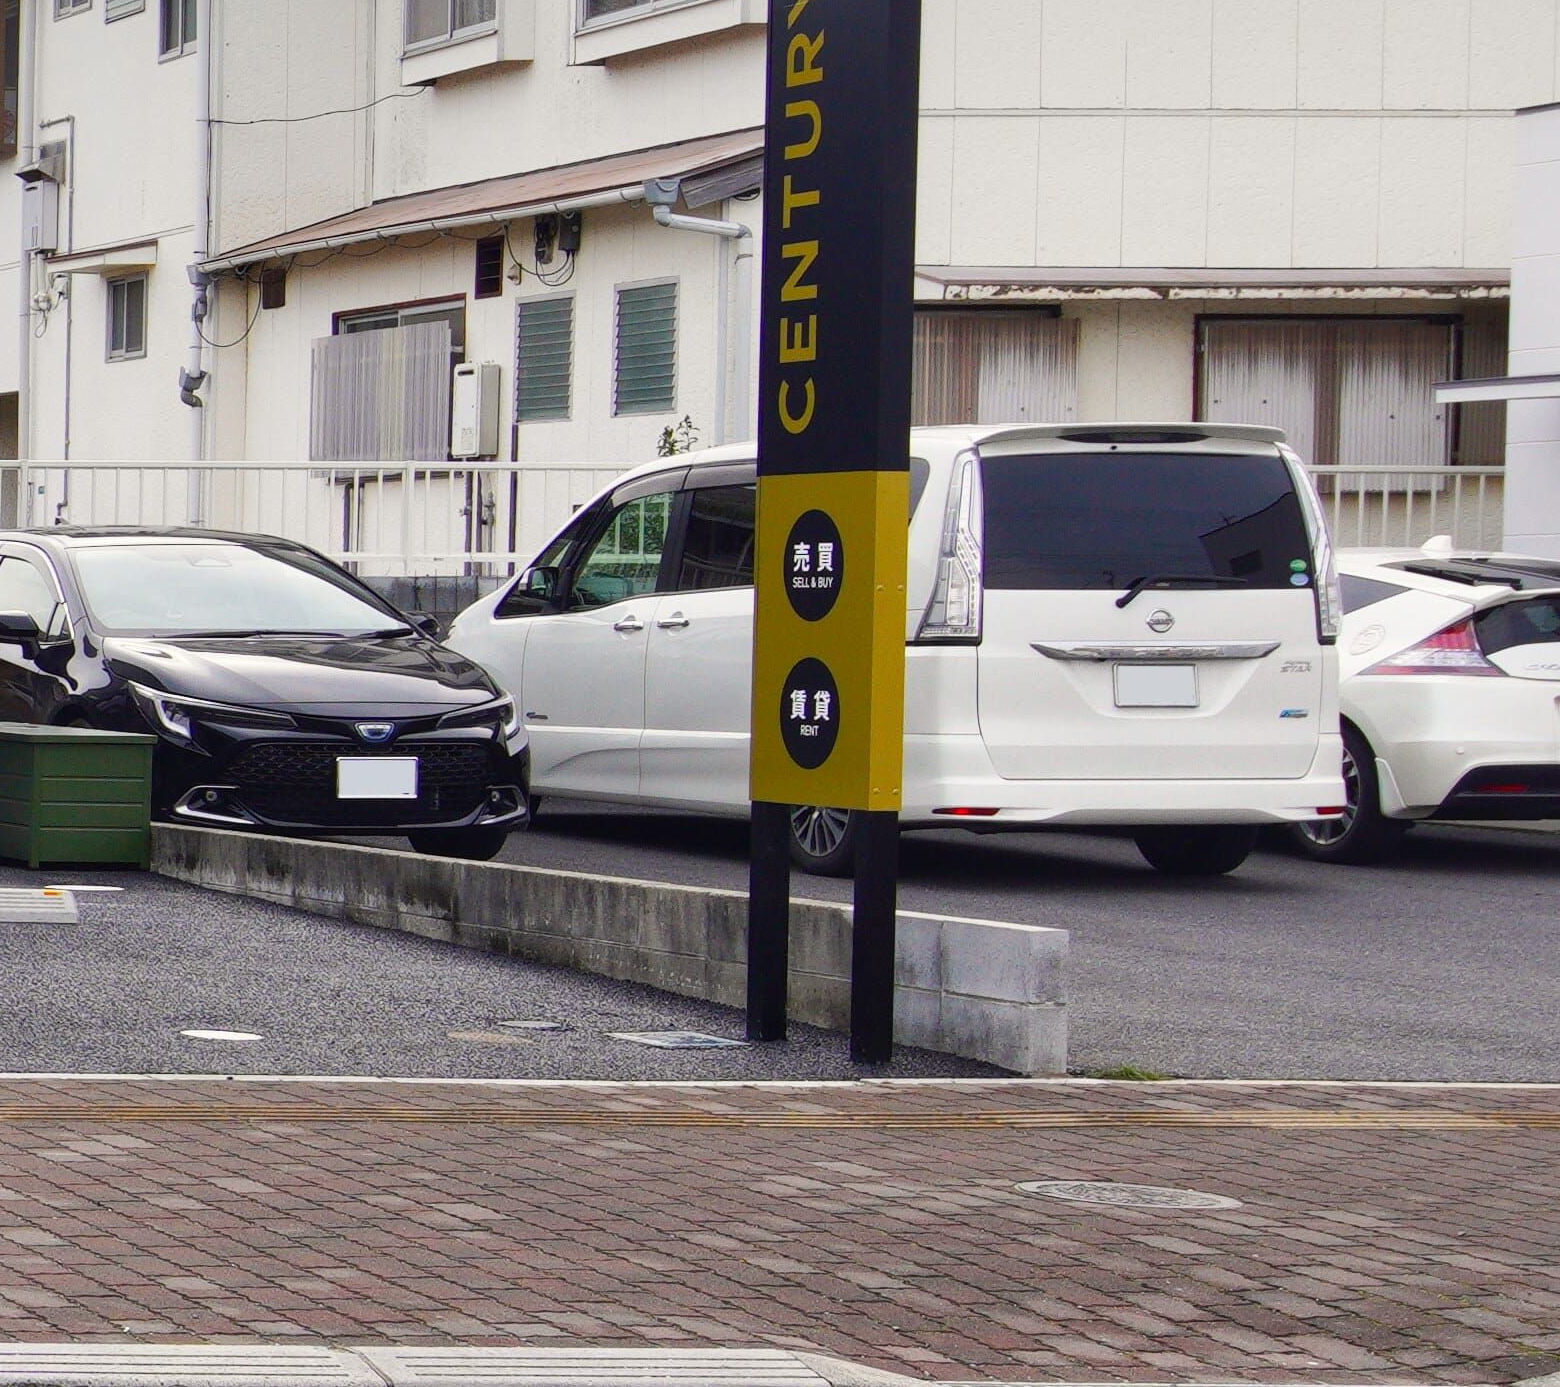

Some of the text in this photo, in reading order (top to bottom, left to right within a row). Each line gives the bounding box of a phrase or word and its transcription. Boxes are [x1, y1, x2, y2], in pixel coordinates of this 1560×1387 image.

[793, 541, 834, 572] 売買
[792, 576, 834, 588] SELL & BUY
[790, 689, 831, 721] 賃貸
[800, 724, 820, 737] RENT
